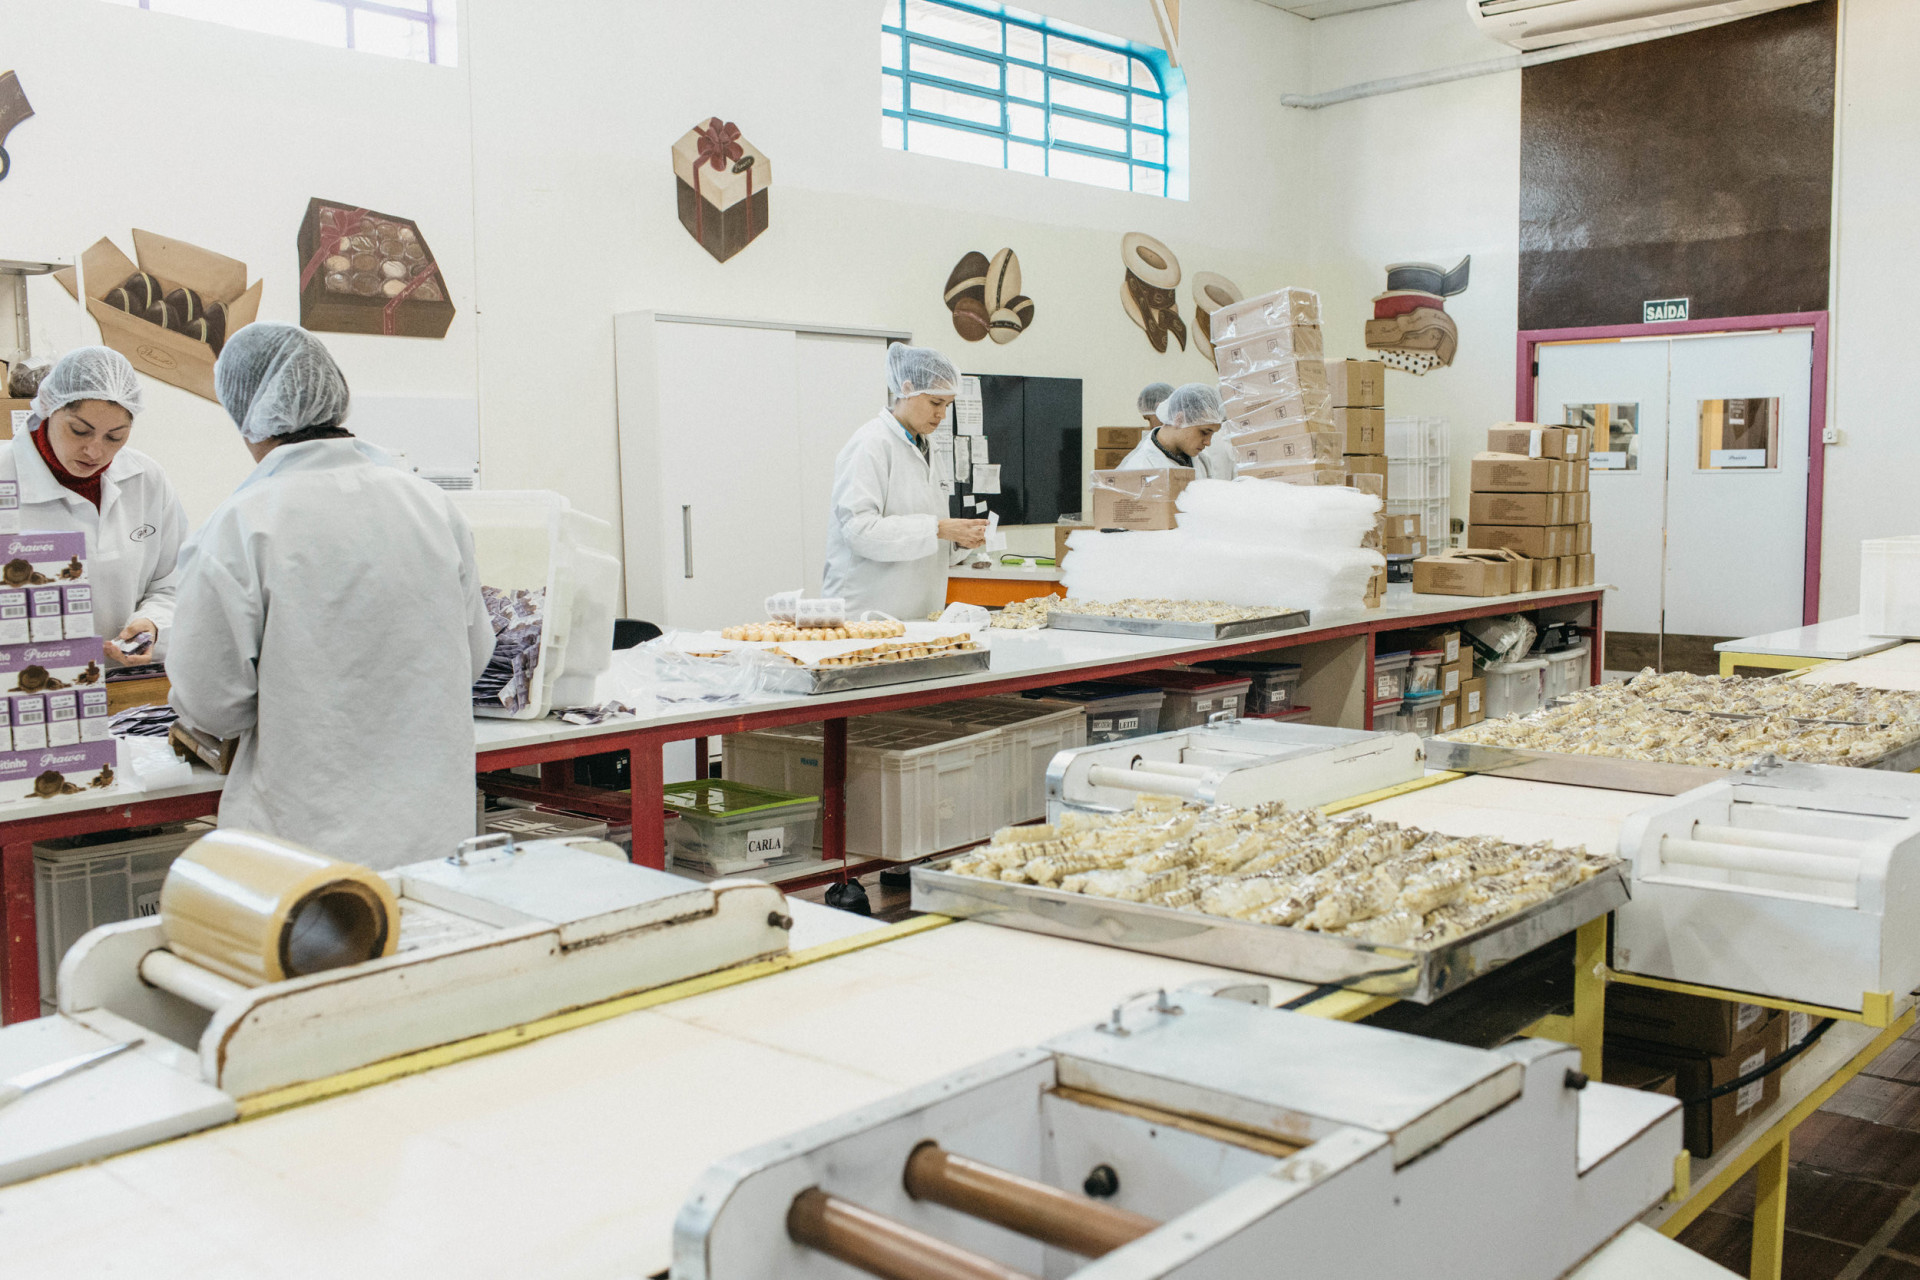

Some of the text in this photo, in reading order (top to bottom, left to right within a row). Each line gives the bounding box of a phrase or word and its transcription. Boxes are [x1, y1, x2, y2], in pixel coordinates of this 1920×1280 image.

[1646, 302, 1686, 320] SAÍDA
[8, 541, 54, 554] Prawer
[23, 648, 71, 661] Prawer
[1119, 720, 1137, 729] LEITE
[39, 753, 86, 767] Prawer
[748, 838, 781, 852] CARLA
